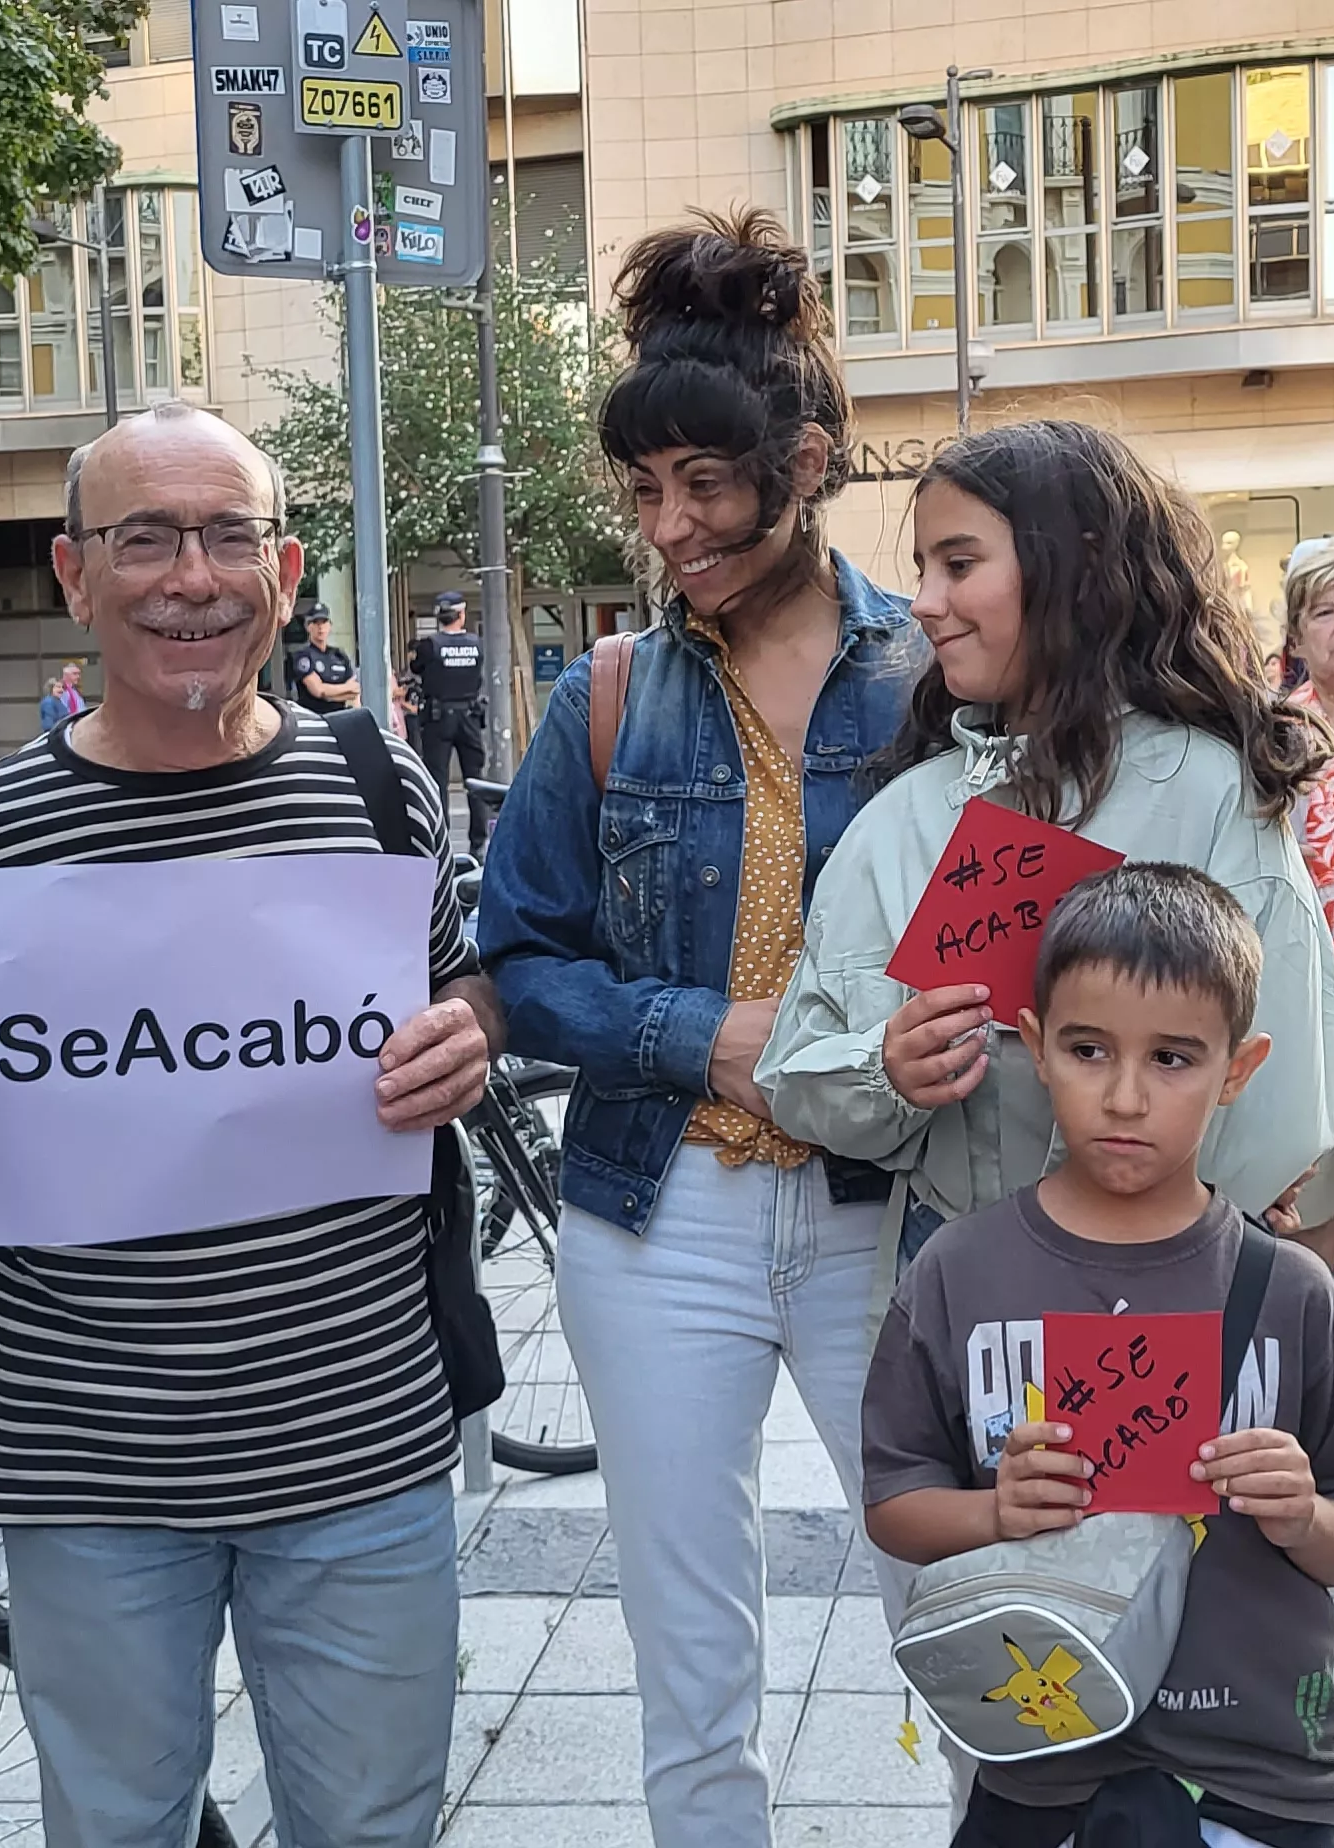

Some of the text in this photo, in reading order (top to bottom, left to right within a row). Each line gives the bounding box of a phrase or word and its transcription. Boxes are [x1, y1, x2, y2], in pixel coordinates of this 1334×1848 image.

[306, 39, 342, 63] TC
[214, 68, 280, 92] SMAK47
[306, 86, 395, 120] Z07661
[943, 843, 1046, 892] #SE
[934, 898, 1065, 964] ACAB
[1052, 1333, 1156, 1417] #SE
[1189, 1687, 1220, 1710] ALL
